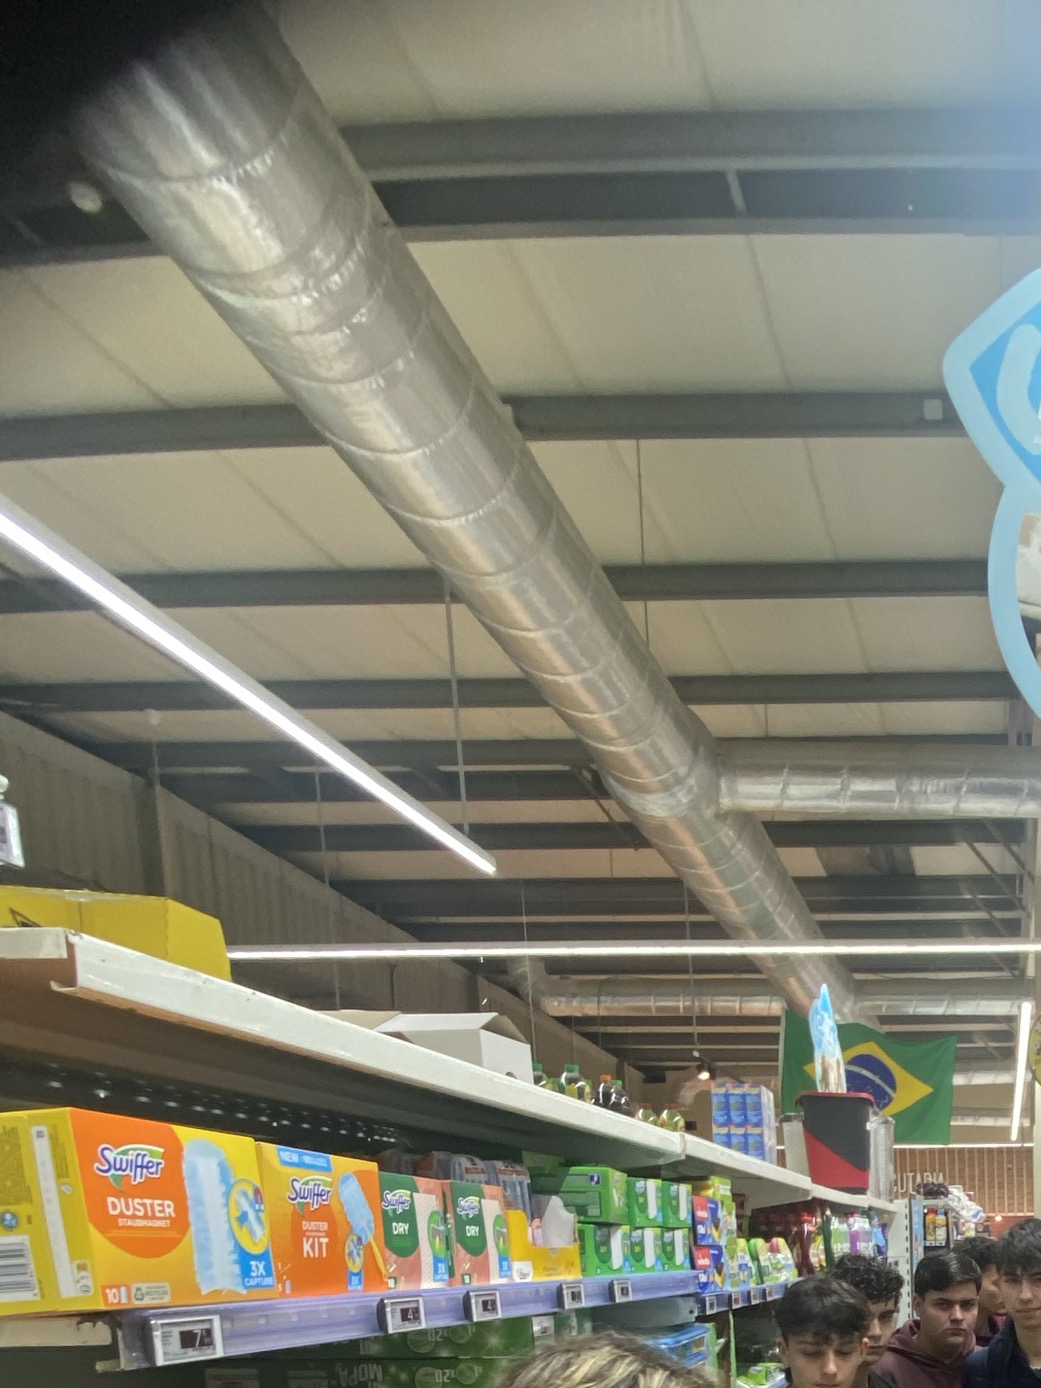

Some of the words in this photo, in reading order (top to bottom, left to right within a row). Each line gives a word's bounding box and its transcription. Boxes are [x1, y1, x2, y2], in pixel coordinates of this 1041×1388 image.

[95, 1145, 165, 1184] Swiffer
[279, 1151, 299, 1164] NEW
[288, 1178, 332, 1210] Swiffer
[382, 1190, 412, 1213] Swiffer
[106, 1197, 176, 1218] DUSTER
[457, 1196, 481, 1217] Swiffer
[302, 1220, 328, 1232] DUSTER
[392, 1222, 410, 1235] DRY
[465, 1225, 479, 1237] DRY
[302, 1237, 329, 1258] KIT
[249, 1261, 267, 1276] 3X
[244, 1276, 274, 1287] CAPTURE
[105, 1288, 119, 1304] 10
